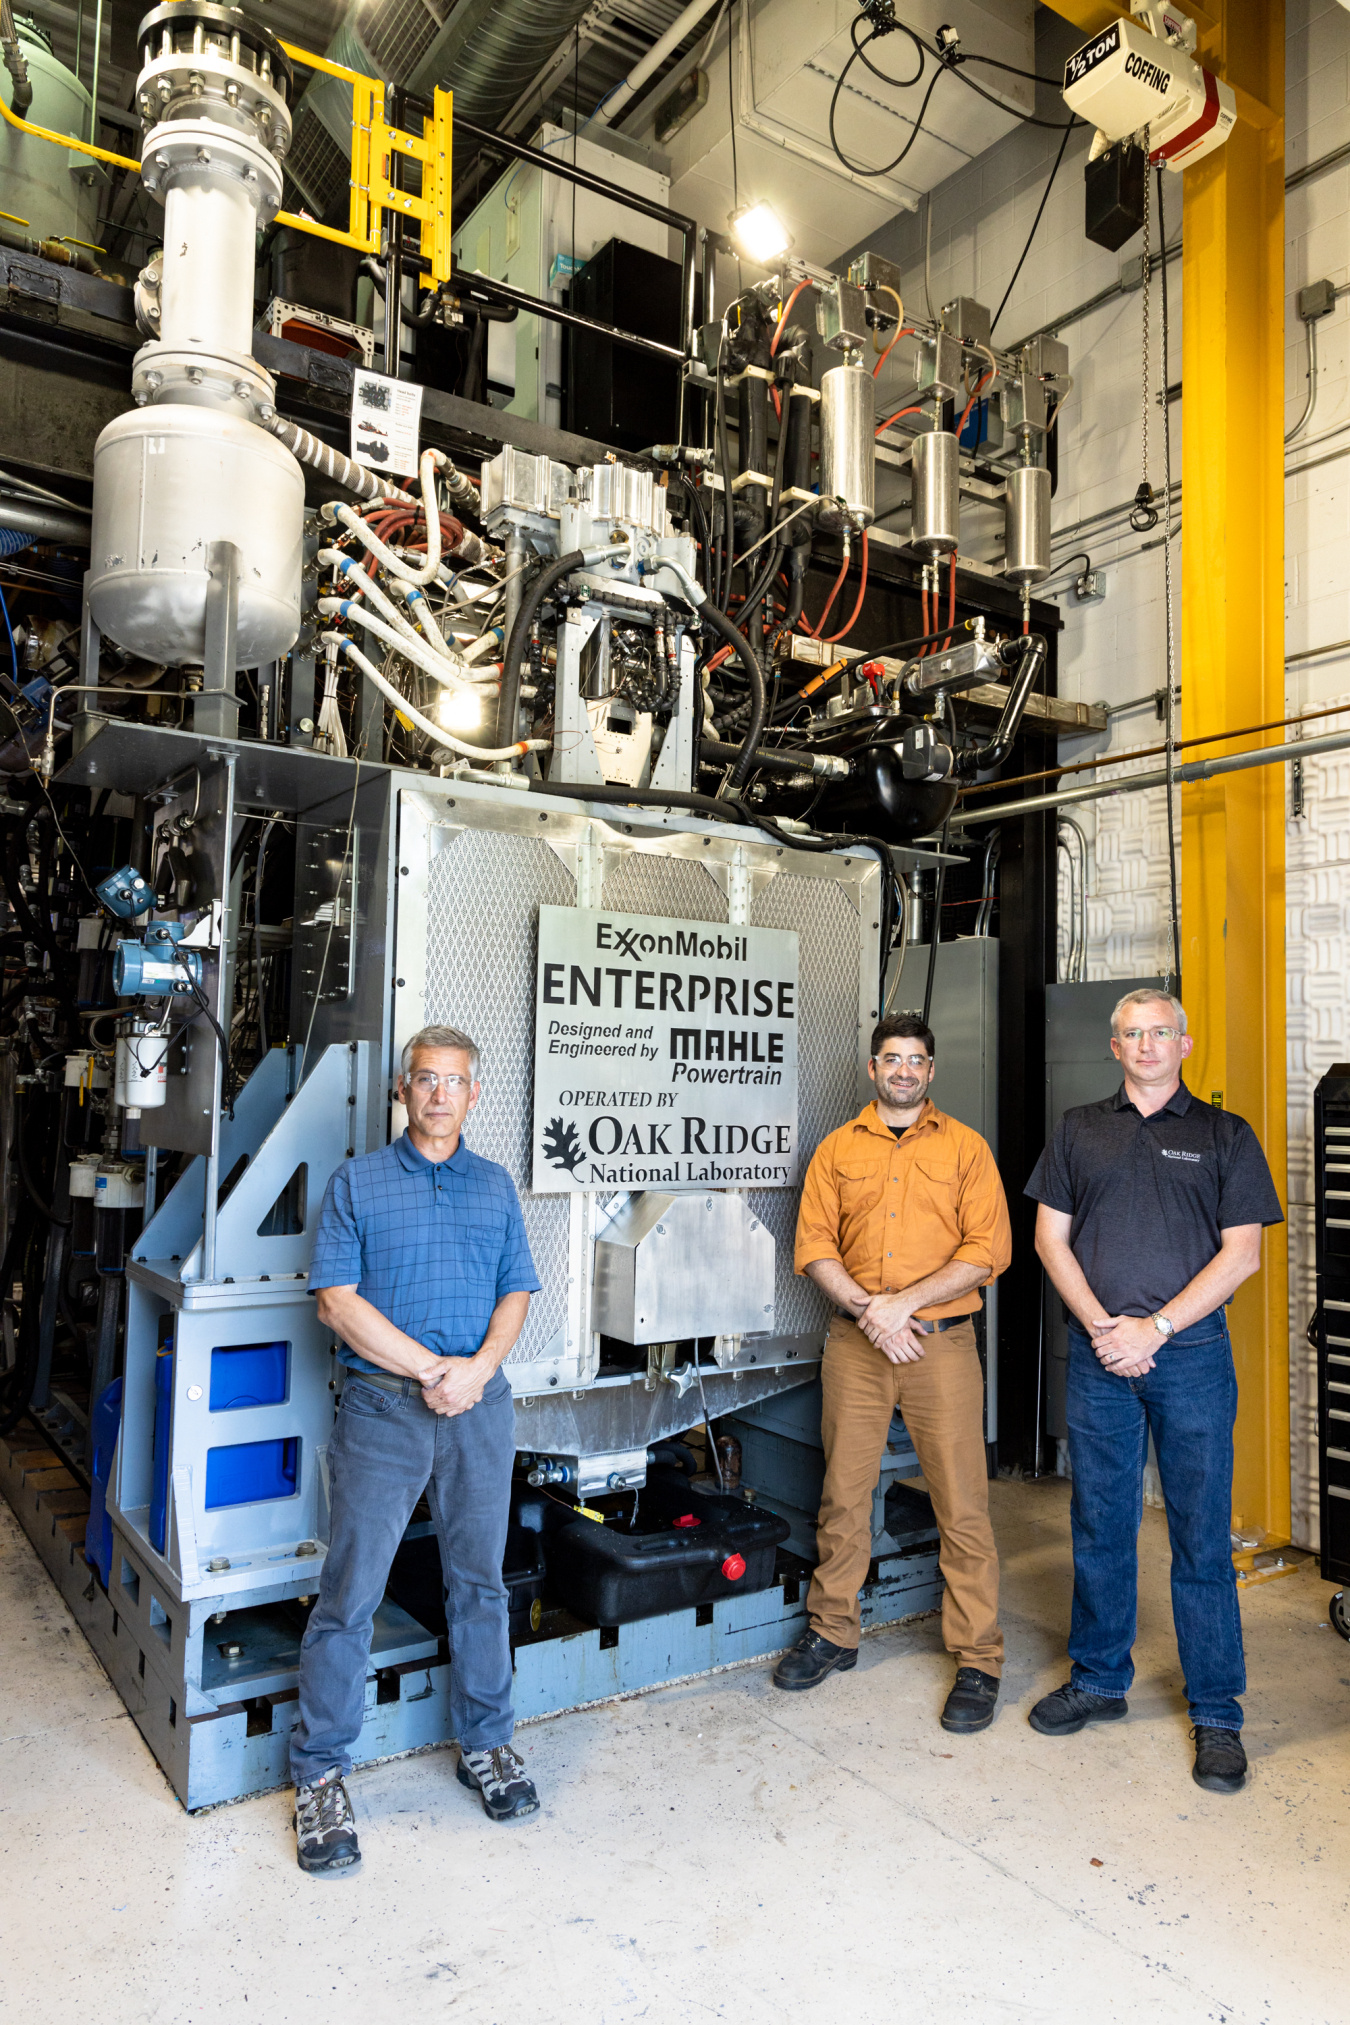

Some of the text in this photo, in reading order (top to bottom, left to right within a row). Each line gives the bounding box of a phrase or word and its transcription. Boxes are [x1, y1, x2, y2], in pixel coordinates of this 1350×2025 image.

[1086, 32, 1116, 65] TON
[1125, 52, 1171, 95] COFFING
[596, 922, 748, 962] ExxonMobil
[543, 962, 795, 1019] ENTERPRISE
[548, 1020, 654, 1040] Designed and
[669, 1027, 784, 1063] MAHLE
[548, 1039, 659, 1061] Engineered by
[671, 1062, 782, 1086] Powertrain
[558, 1090, 679, 1108] OPERATED BY
[588, 1115, 792, 1156] OAK RIDGE
[589, 1161, 792, 1185] National Laboratory
